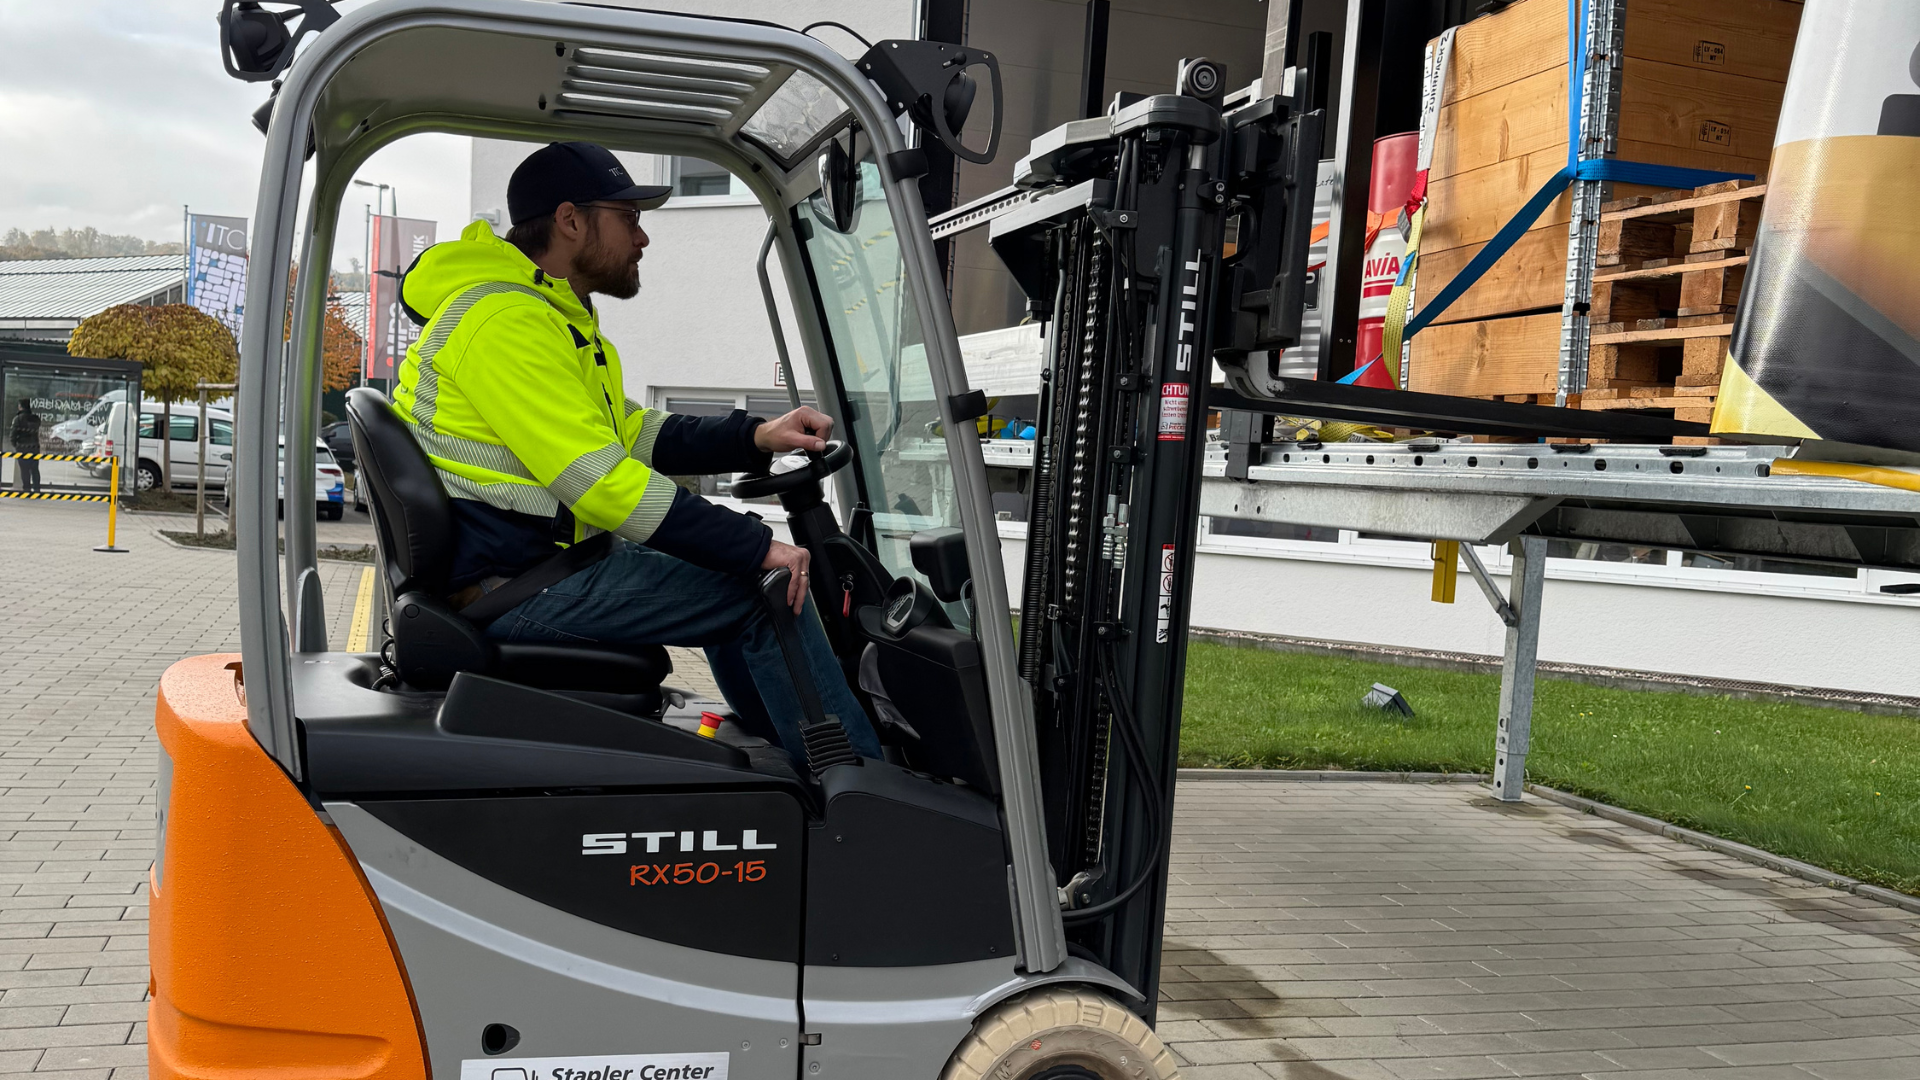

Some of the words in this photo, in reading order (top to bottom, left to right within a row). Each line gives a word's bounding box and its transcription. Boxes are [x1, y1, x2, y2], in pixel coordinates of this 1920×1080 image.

[1428, 47, 1445, 113] ZURRPACK
[206, 222, 245, 250] ITC
[1175, 249, 1201, 372] STILL
[1162, 384, 1190, 396] CHTUN
[582, 829, 777, 855] STILL
[629, 860, 767, 886] RX50-15
[551, 1065, 633, 1080] Stapler
[640, 1063, 714, 1080] Center
